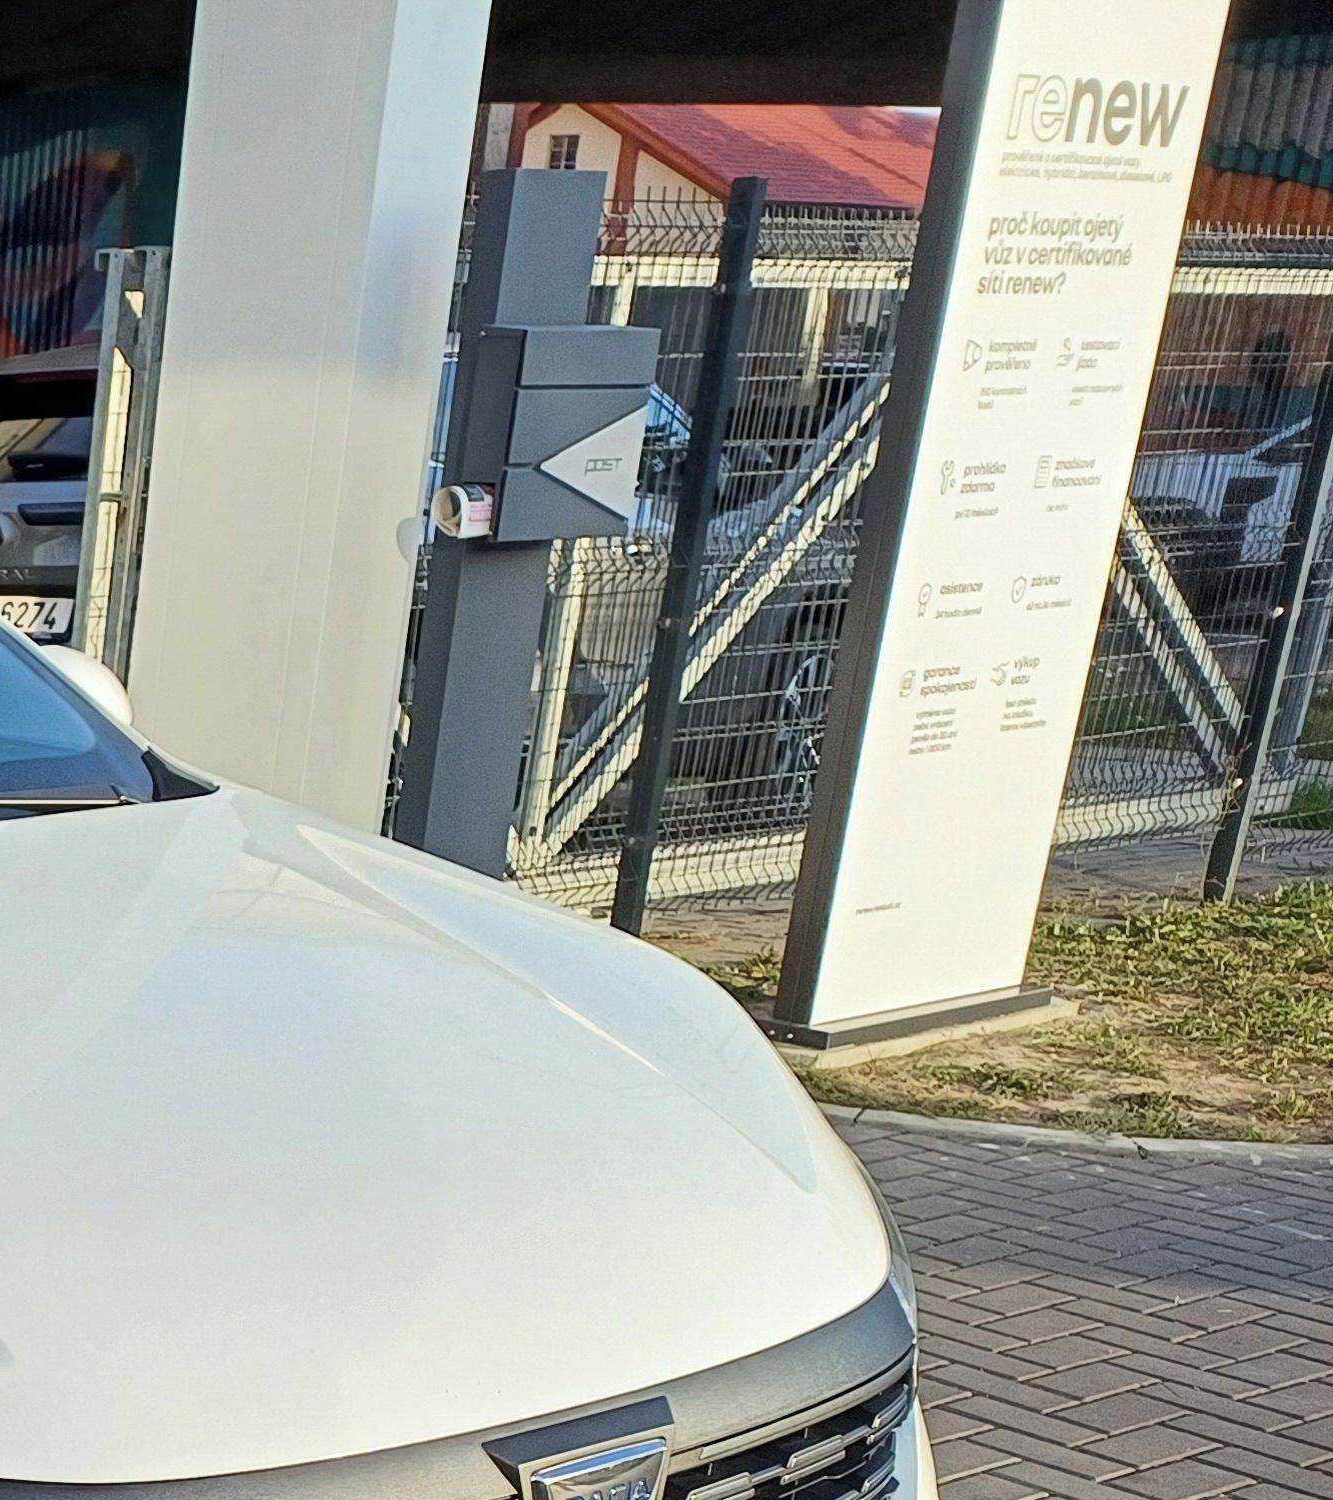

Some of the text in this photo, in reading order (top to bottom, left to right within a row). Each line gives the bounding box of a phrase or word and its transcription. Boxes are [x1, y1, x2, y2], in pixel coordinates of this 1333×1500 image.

[1006, 74, 1190, 147] renew
[988, 211, 1124, 243] proč koupit ojetý
[984, 239, 1133, 266] vůz v certifikované
[978, 270, 1066, 294] síti renew?
